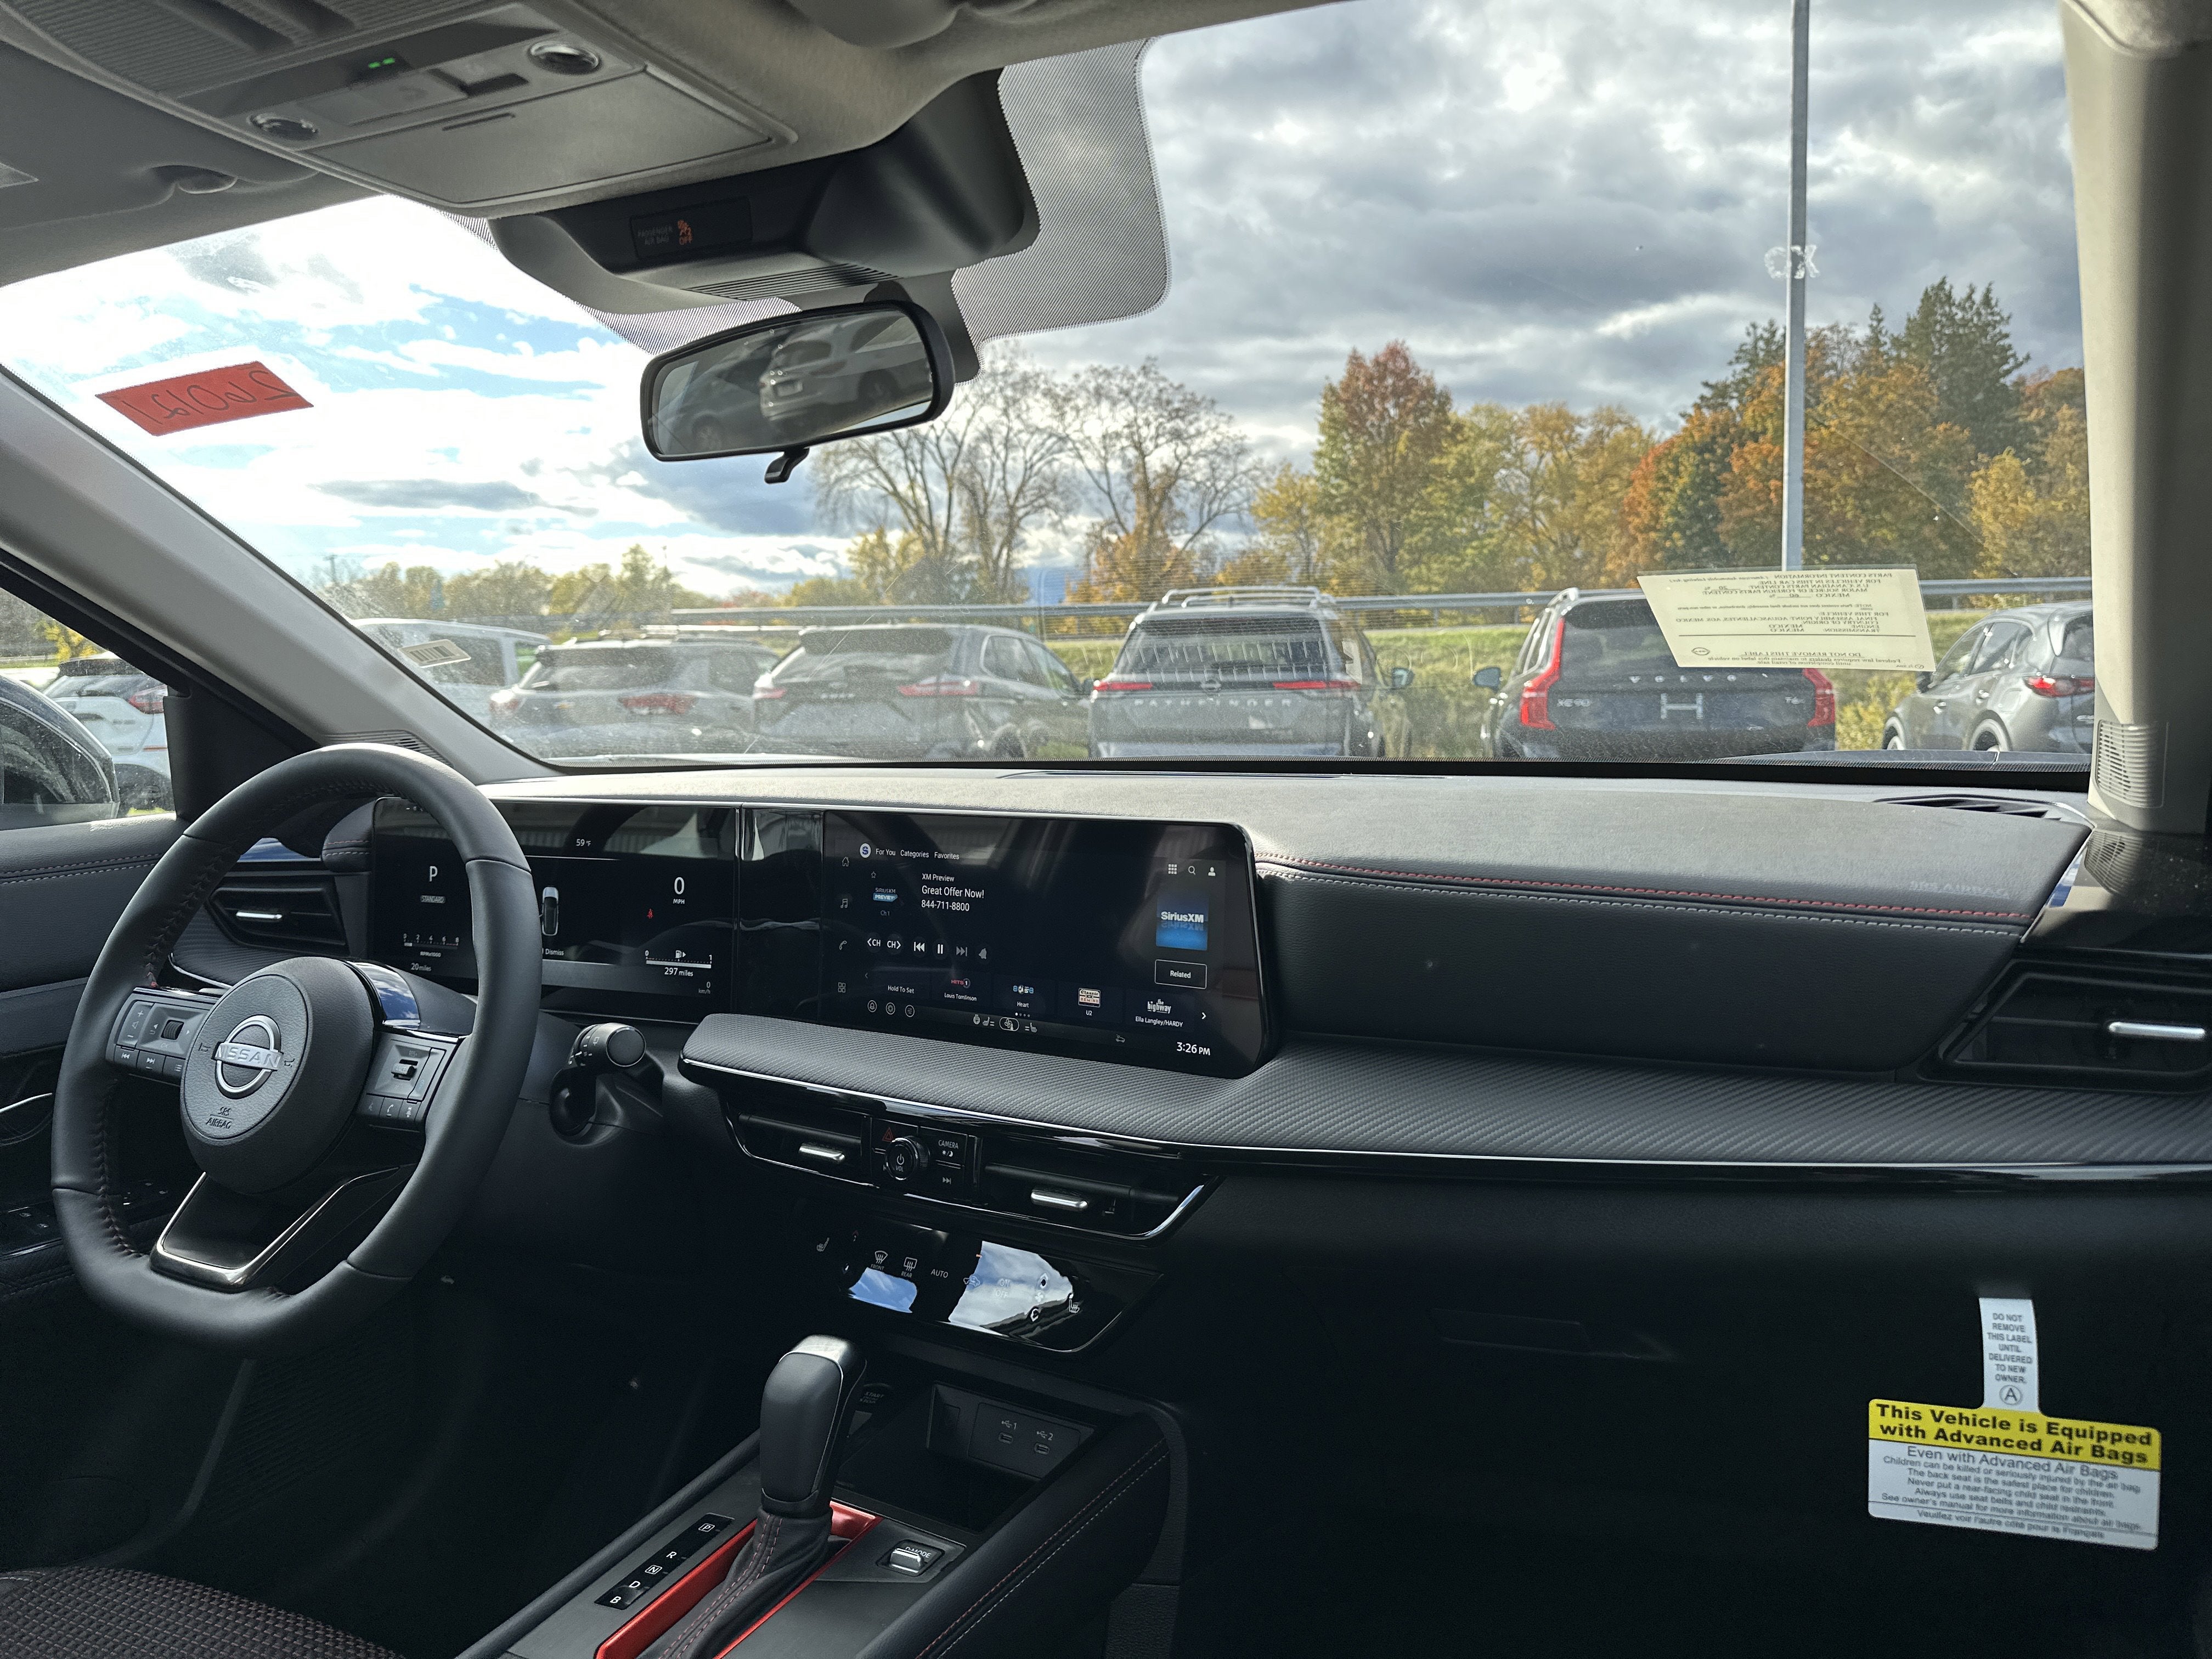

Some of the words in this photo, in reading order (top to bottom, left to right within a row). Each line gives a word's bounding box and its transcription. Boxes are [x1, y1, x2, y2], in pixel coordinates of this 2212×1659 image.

[575, 838, 585, 847] 59
[900, 850, 929, 859] Categories
[934, 851, 960, 860] Favorites
[429, 865, 438, 882] P
[933, 874, 955, 882] Preview
[674, 877, 684, 894] 0
[922, 885, 942, 895] Great
[944, 887, 963, 896] Offer
[964, 888, 984, 899] Now!
[921, 899, 970, 911] 844-711-8800
[1160, 911, 1204, 923] SiriusXM
[545, 947, 565, 956] Dismiss
[410, 962, 419, 970] 20
[664, 967, 678, 975] 297
[1170, 969, 1191, 979] Related
[1147, 1001, 1171, 1014] highway
[1144, 1017, 1183, 1028] Langley/HARDY
[1176, 1041, 1197, 1054] 3:26
[1198, 1047, 1211, 1056] PM
[215, 1044, 281, 1068] NISSAN
[938, 1139, 959, 1149] CAMERA
[930, 1268, 949, 1278] AUTO
[999, 1277, 1011, 1288] ON
[995, 1289, 1008, 1299] OFF
[1992, 1312, 2005, 1321] DO
[2006, 1313, 2022, 1322] NOT
[1991, 1322, 2026, 1332] REMOVE
[1987, 1332, 2005, 1341] THIS
[2006, 1333, 2032, 1342] LABEL
[1998, 1344, 2022, 1352] UNTIL
[1988, 1353, 2033, 1363] DELIVERED
[1995, 1363, 2005, 1372] TO
[2007, 1364, 2026, 1373] NEW
[1876, 1403, 1922, 1421] This
[1930, 1409, 2011, 1431] Vehicle
[2019, 1418, 2037, 1434] is
[2046, 1421, 2152, 1448] Equipped
[1047, 1432, 1053, 1441] 2
[1879, 1421, 1926, 1440] with
[1934, 1427, 2042, 1452] Advanced
[2050, 1439, 2084, 1456] Air
[2091, 1443, 2148, 1466] Bags
[1883, 1455, 1921, 1468] Children
[1923, 1462, 1940, 1470] can
[1942, 1462, 1954, 1471] be
[1956, 1463, 1980, 1474] killed
[1908, 1446, 1942, 1460] Even
[1946, 1450, 1976, 1464] with
[1978, 1453, 2050, 1471] Advanced
[2053, 1461, 2075, 1474] Air
[1908, 1468, 1925, 1477] The
[1927, 1470, 1948, 1480] back
[1953, 1472, 1971, 1482] seat
[1974, 1475, 1980, 1483] is
[1984, 1476, 1999, 1486] the
[1908, 1477, 1934, 1488] Never
[1937, 1481, 1952, 1491] put
[1882, 1493, 1899, 1503] See
[1939, 1499, 1972, 1510] manual
[1975, 1503, 1987, 1512] for
